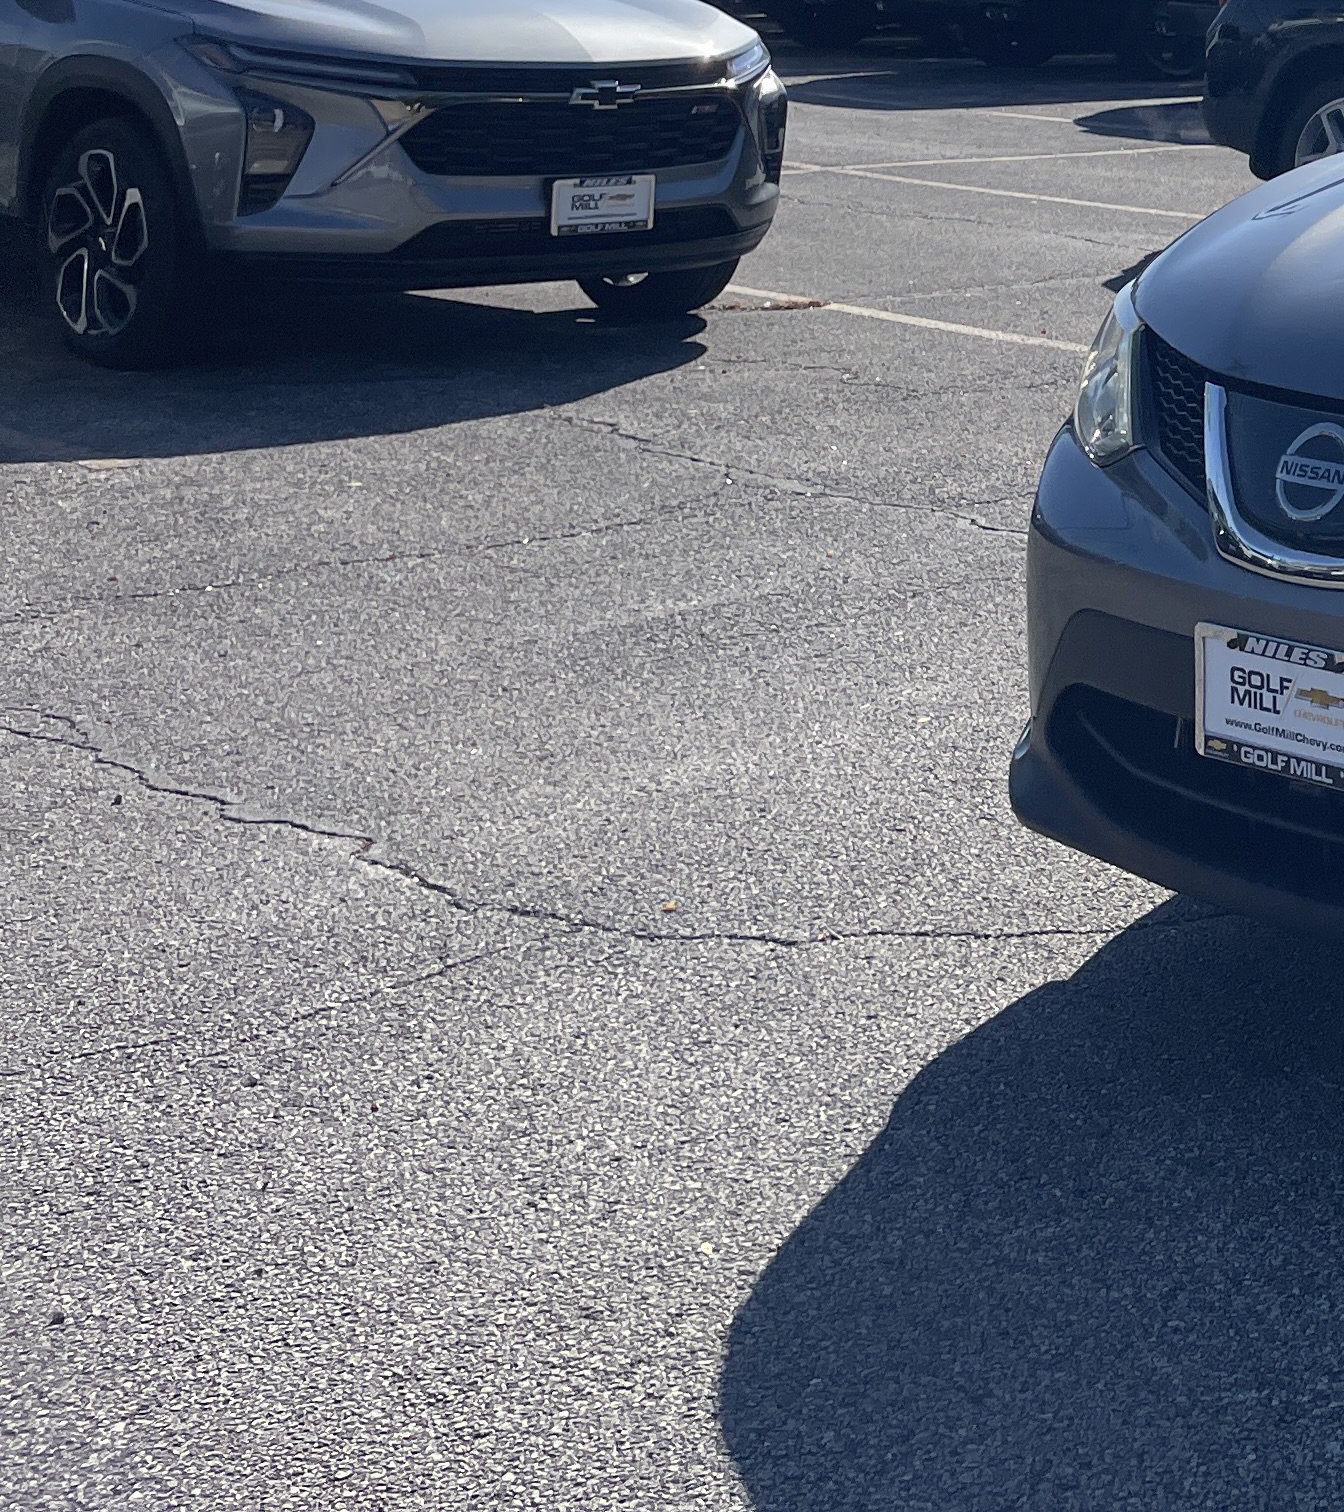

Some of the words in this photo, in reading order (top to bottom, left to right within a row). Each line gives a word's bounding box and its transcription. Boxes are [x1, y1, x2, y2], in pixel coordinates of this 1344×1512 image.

[1243, 636, 1328, 668] NILES
[1230, 666, 1293, 695] GOLF
[1230, 685, 1281, 715] MILL
[1240, 746, 1288, 771] GOLF
[1290, 758, 1333, 784] MILL
